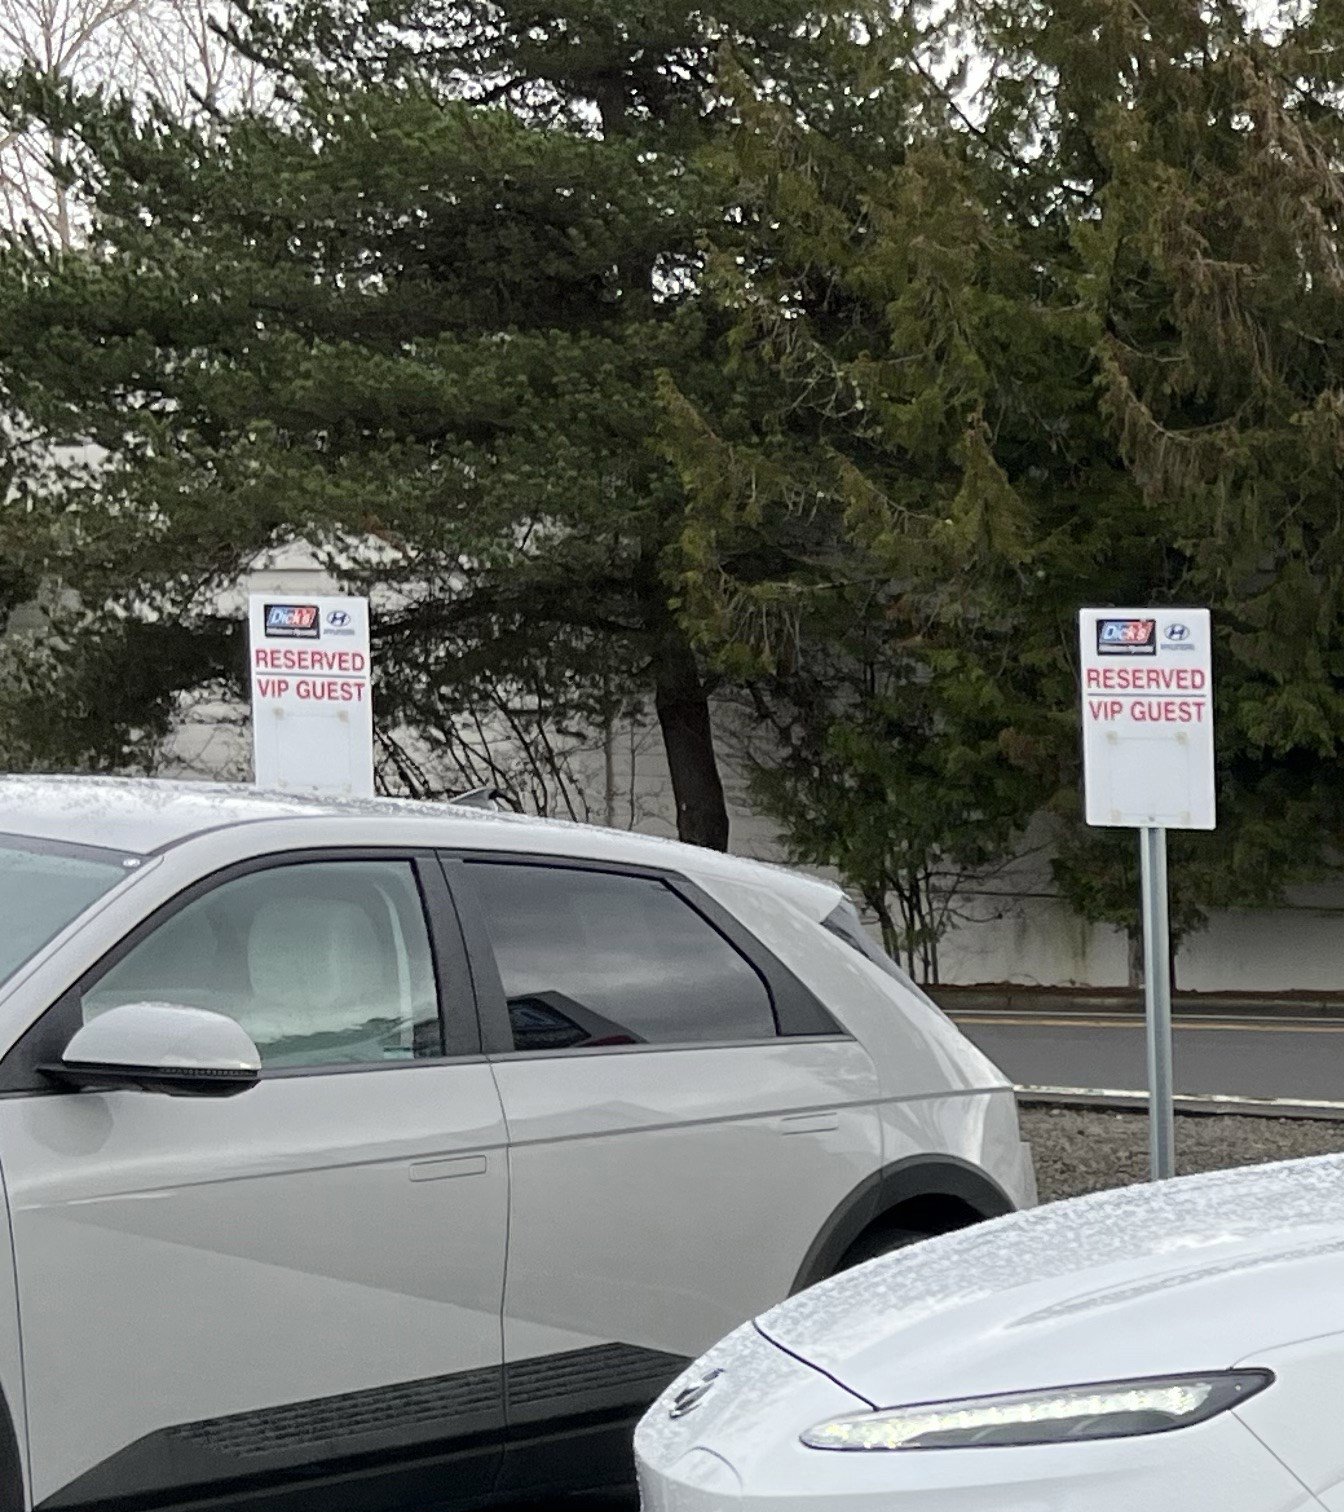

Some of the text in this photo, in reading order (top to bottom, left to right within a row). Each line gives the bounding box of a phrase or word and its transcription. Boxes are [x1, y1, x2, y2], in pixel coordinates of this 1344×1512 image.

[255, 649, 365, 671] RESERVED
[1087, 668, 1205, 689] RESERVED
[257, 679, 365, 701] VIP GUEST
[1089, 701, 1206, 722] VIP GUEST
